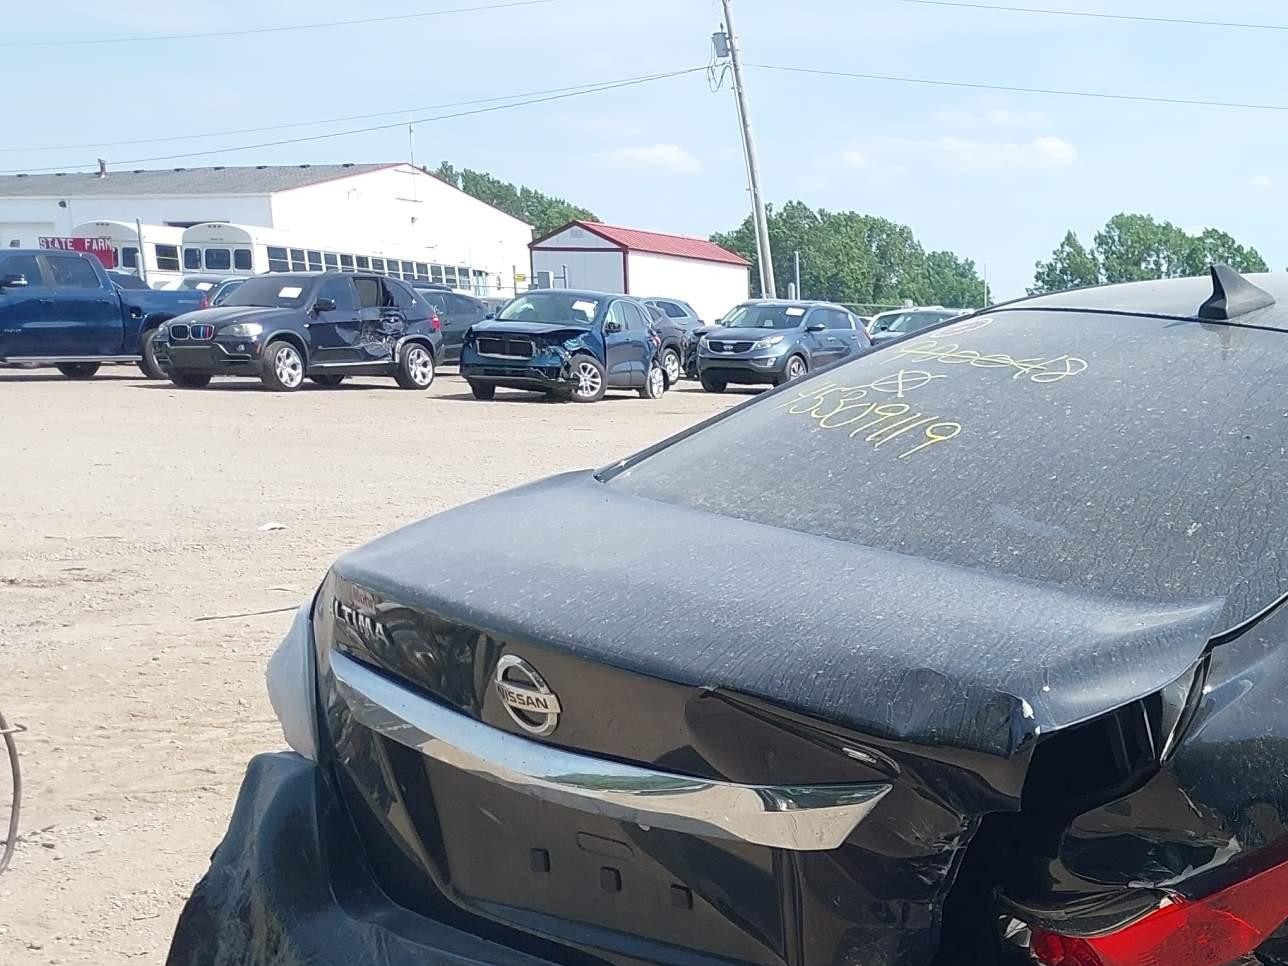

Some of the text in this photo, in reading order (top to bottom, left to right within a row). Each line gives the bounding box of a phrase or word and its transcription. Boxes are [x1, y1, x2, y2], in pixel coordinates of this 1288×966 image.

[39, 238, 113, 252] STATE FARM
[497, 686, 549, 710] NISSAN
